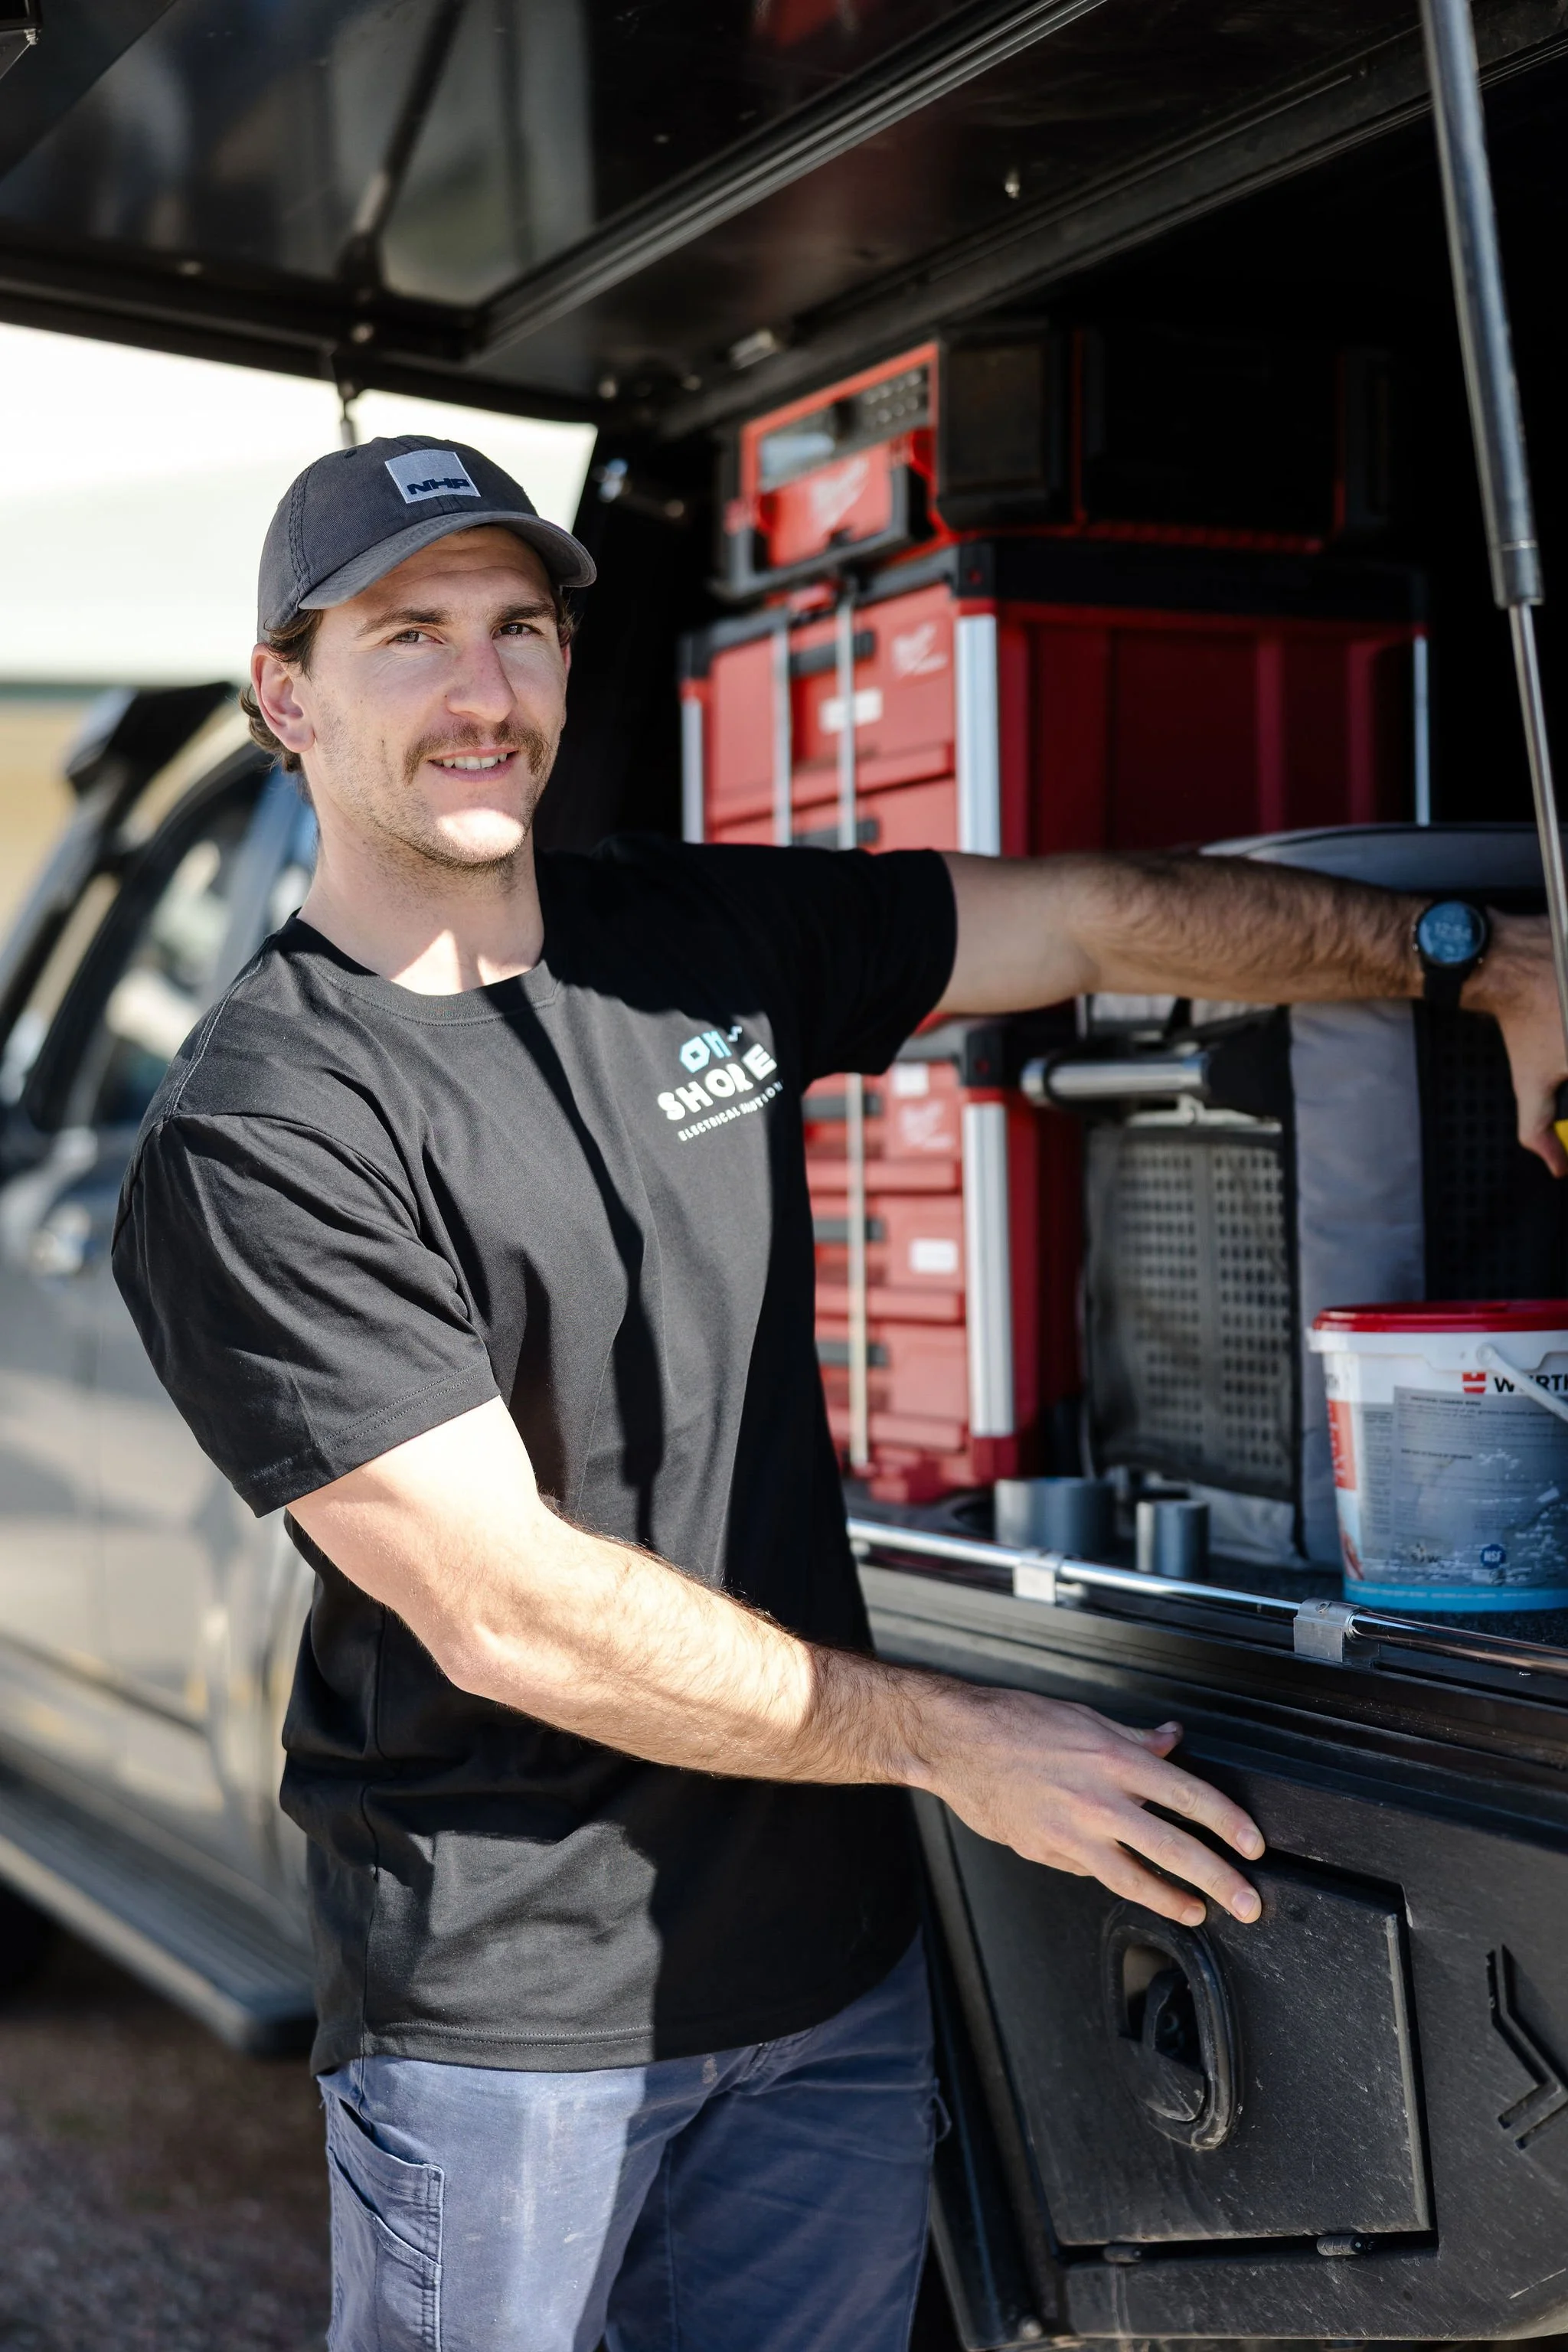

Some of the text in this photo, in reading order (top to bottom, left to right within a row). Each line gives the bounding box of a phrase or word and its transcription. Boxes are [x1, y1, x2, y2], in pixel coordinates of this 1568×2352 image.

[407, 478, 470, 495] NHP
[657, 1043, 778, 1121] SHORE
[678, 1106, 741, 1142] ELECTRICAL
[1494, 1374, 1568, 1393] WRT
[1484, 1550, 1502, 1563] NSF
